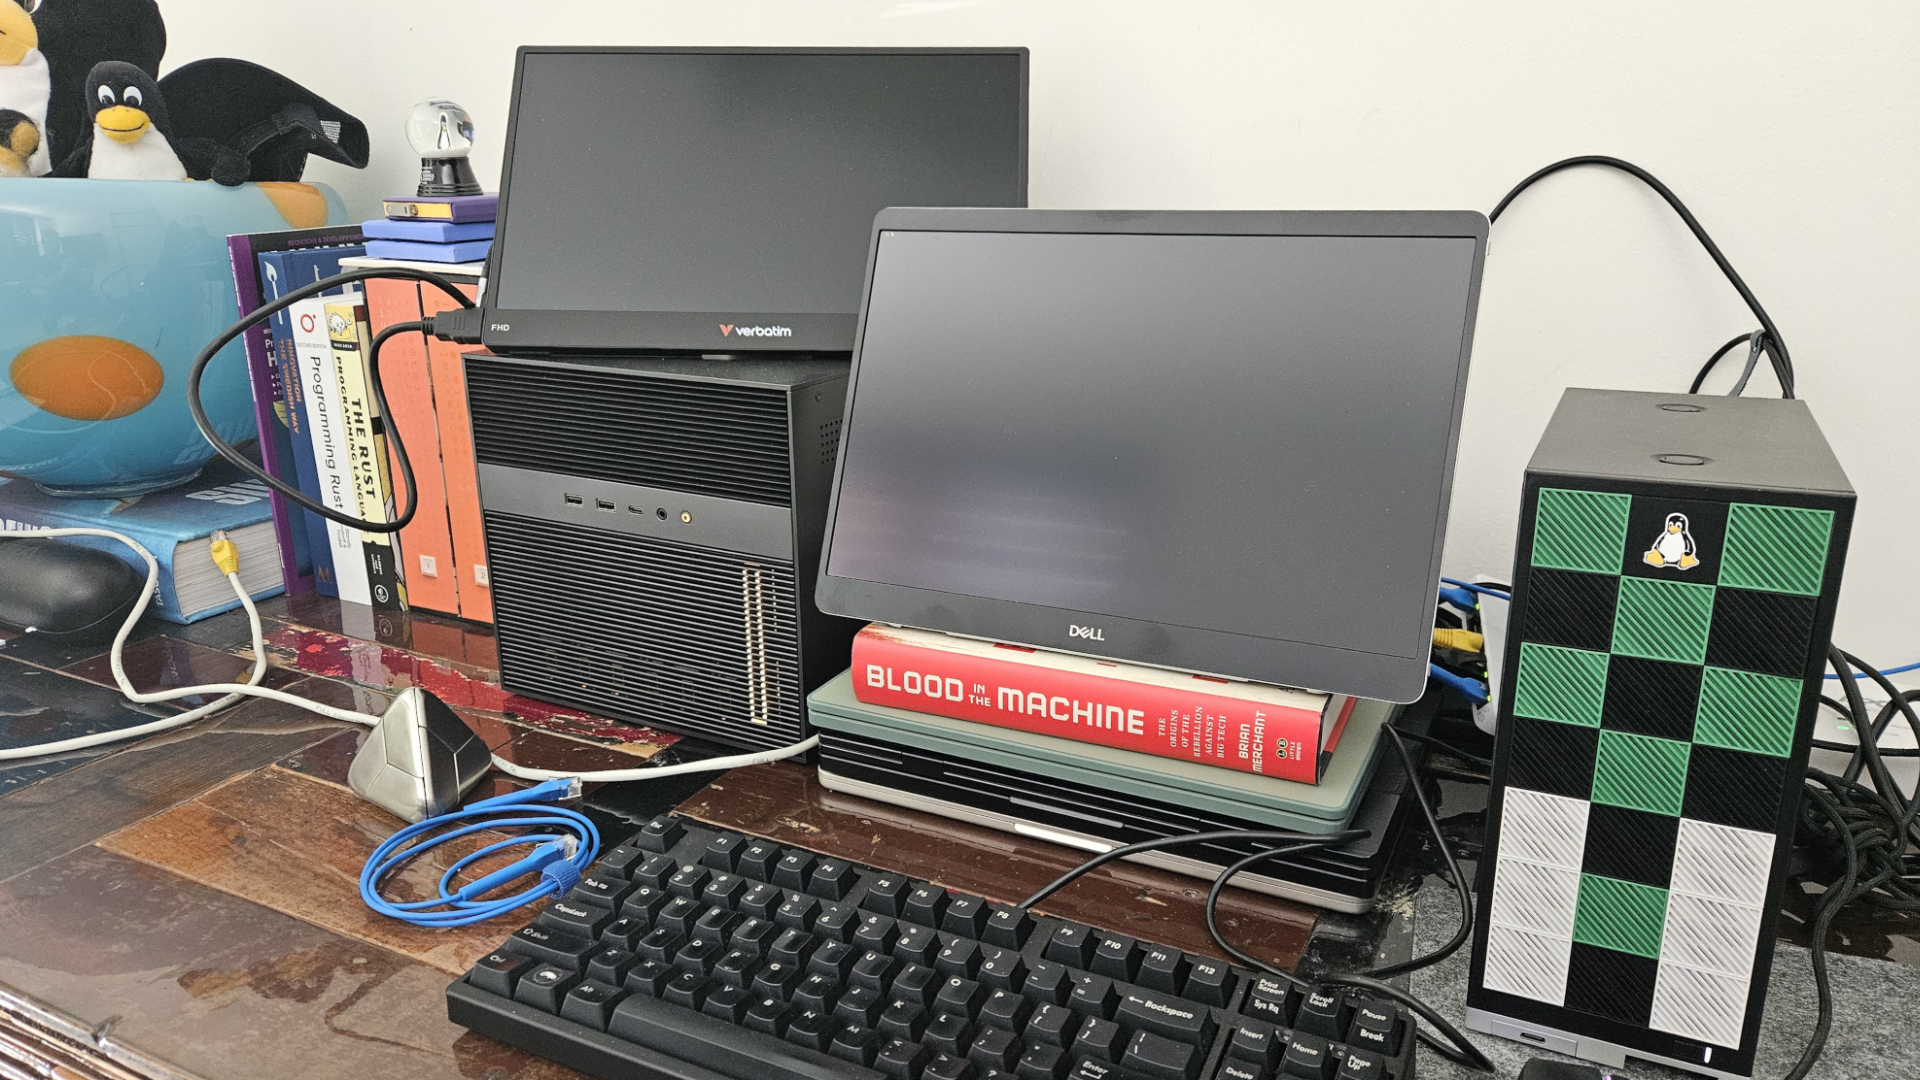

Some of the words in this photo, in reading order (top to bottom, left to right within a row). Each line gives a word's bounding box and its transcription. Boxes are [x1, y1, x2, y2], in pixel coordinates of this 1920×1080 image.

[322, 233, 366, 243] DÉVELOPPEMEN
[491, 324, 510, 332] FHD
[734, 325, 792, 338] verbatim
[278, 338, 287, 360] THE
[286, 338, 302, 402] INNOVATION
[282, 363, 295, 410] SWEDISH
[336, 356, 357, 461] PROGRAMMING
[291, 412, 300, 434] WAY
[310, 356, 336, 470] Programming
[330, 474, 344, 509] Rust
[351, 398, 366, 438] THE
[359, 446, 376, 499] RUST
[1069, 624, 1105, 641] DELL
[866, 664, 964, 702] BLOOD
[973, 683, 985, 695] IN
[968, 694, 991, 707] THE
[997, 686, 1145, 735] MACHINE
[1158, 718, 1166, 736] THE
[1170, 709, 1178, 748] ORIGINS
[1194, 706, 1203, 758] REBELLION
[1218, 716, 1226, 742] TECH
[1205, 715, 1214, 755] AGAINST
[1238, 723, 1250, 759] BRIAN
[1252, 710, 1266, 772] MERCHANT
[1182, 737, 1188, 748] OF
[997, 911, 1009, 919] F8
[1105, 940, 1121, 949] F10
[1151, 952, 1166, 961] F11
[1198, 965, 1215, 974] F12
[1260, 979, 1279, 988] Print
[1258, 985, 1284, 996] Screen
[1309, 998, 1328, 1008] Lock
[1311, 992, 1333, 1003] Scroll
[1145, 1000, 1193, 1018] Backspace
[1254, 999, 1266, 1009] Sys
[1269, 1003, 1279, 1014] Rq
[1362, 1009, 1386, 1020] Pause
[1240, 1028, 1263, 1039] Insert
[1360, 1029, 1384, 1041] Break
[1293, 1042, 1318, 1055] Home
[1082, 1061, 1108, 1074] Enter
[1348, 1061, 1361, 1070] Up
[1350, 1055, 1371, 1067] Page
[1226, 1067, 1253, 1079] Delete
